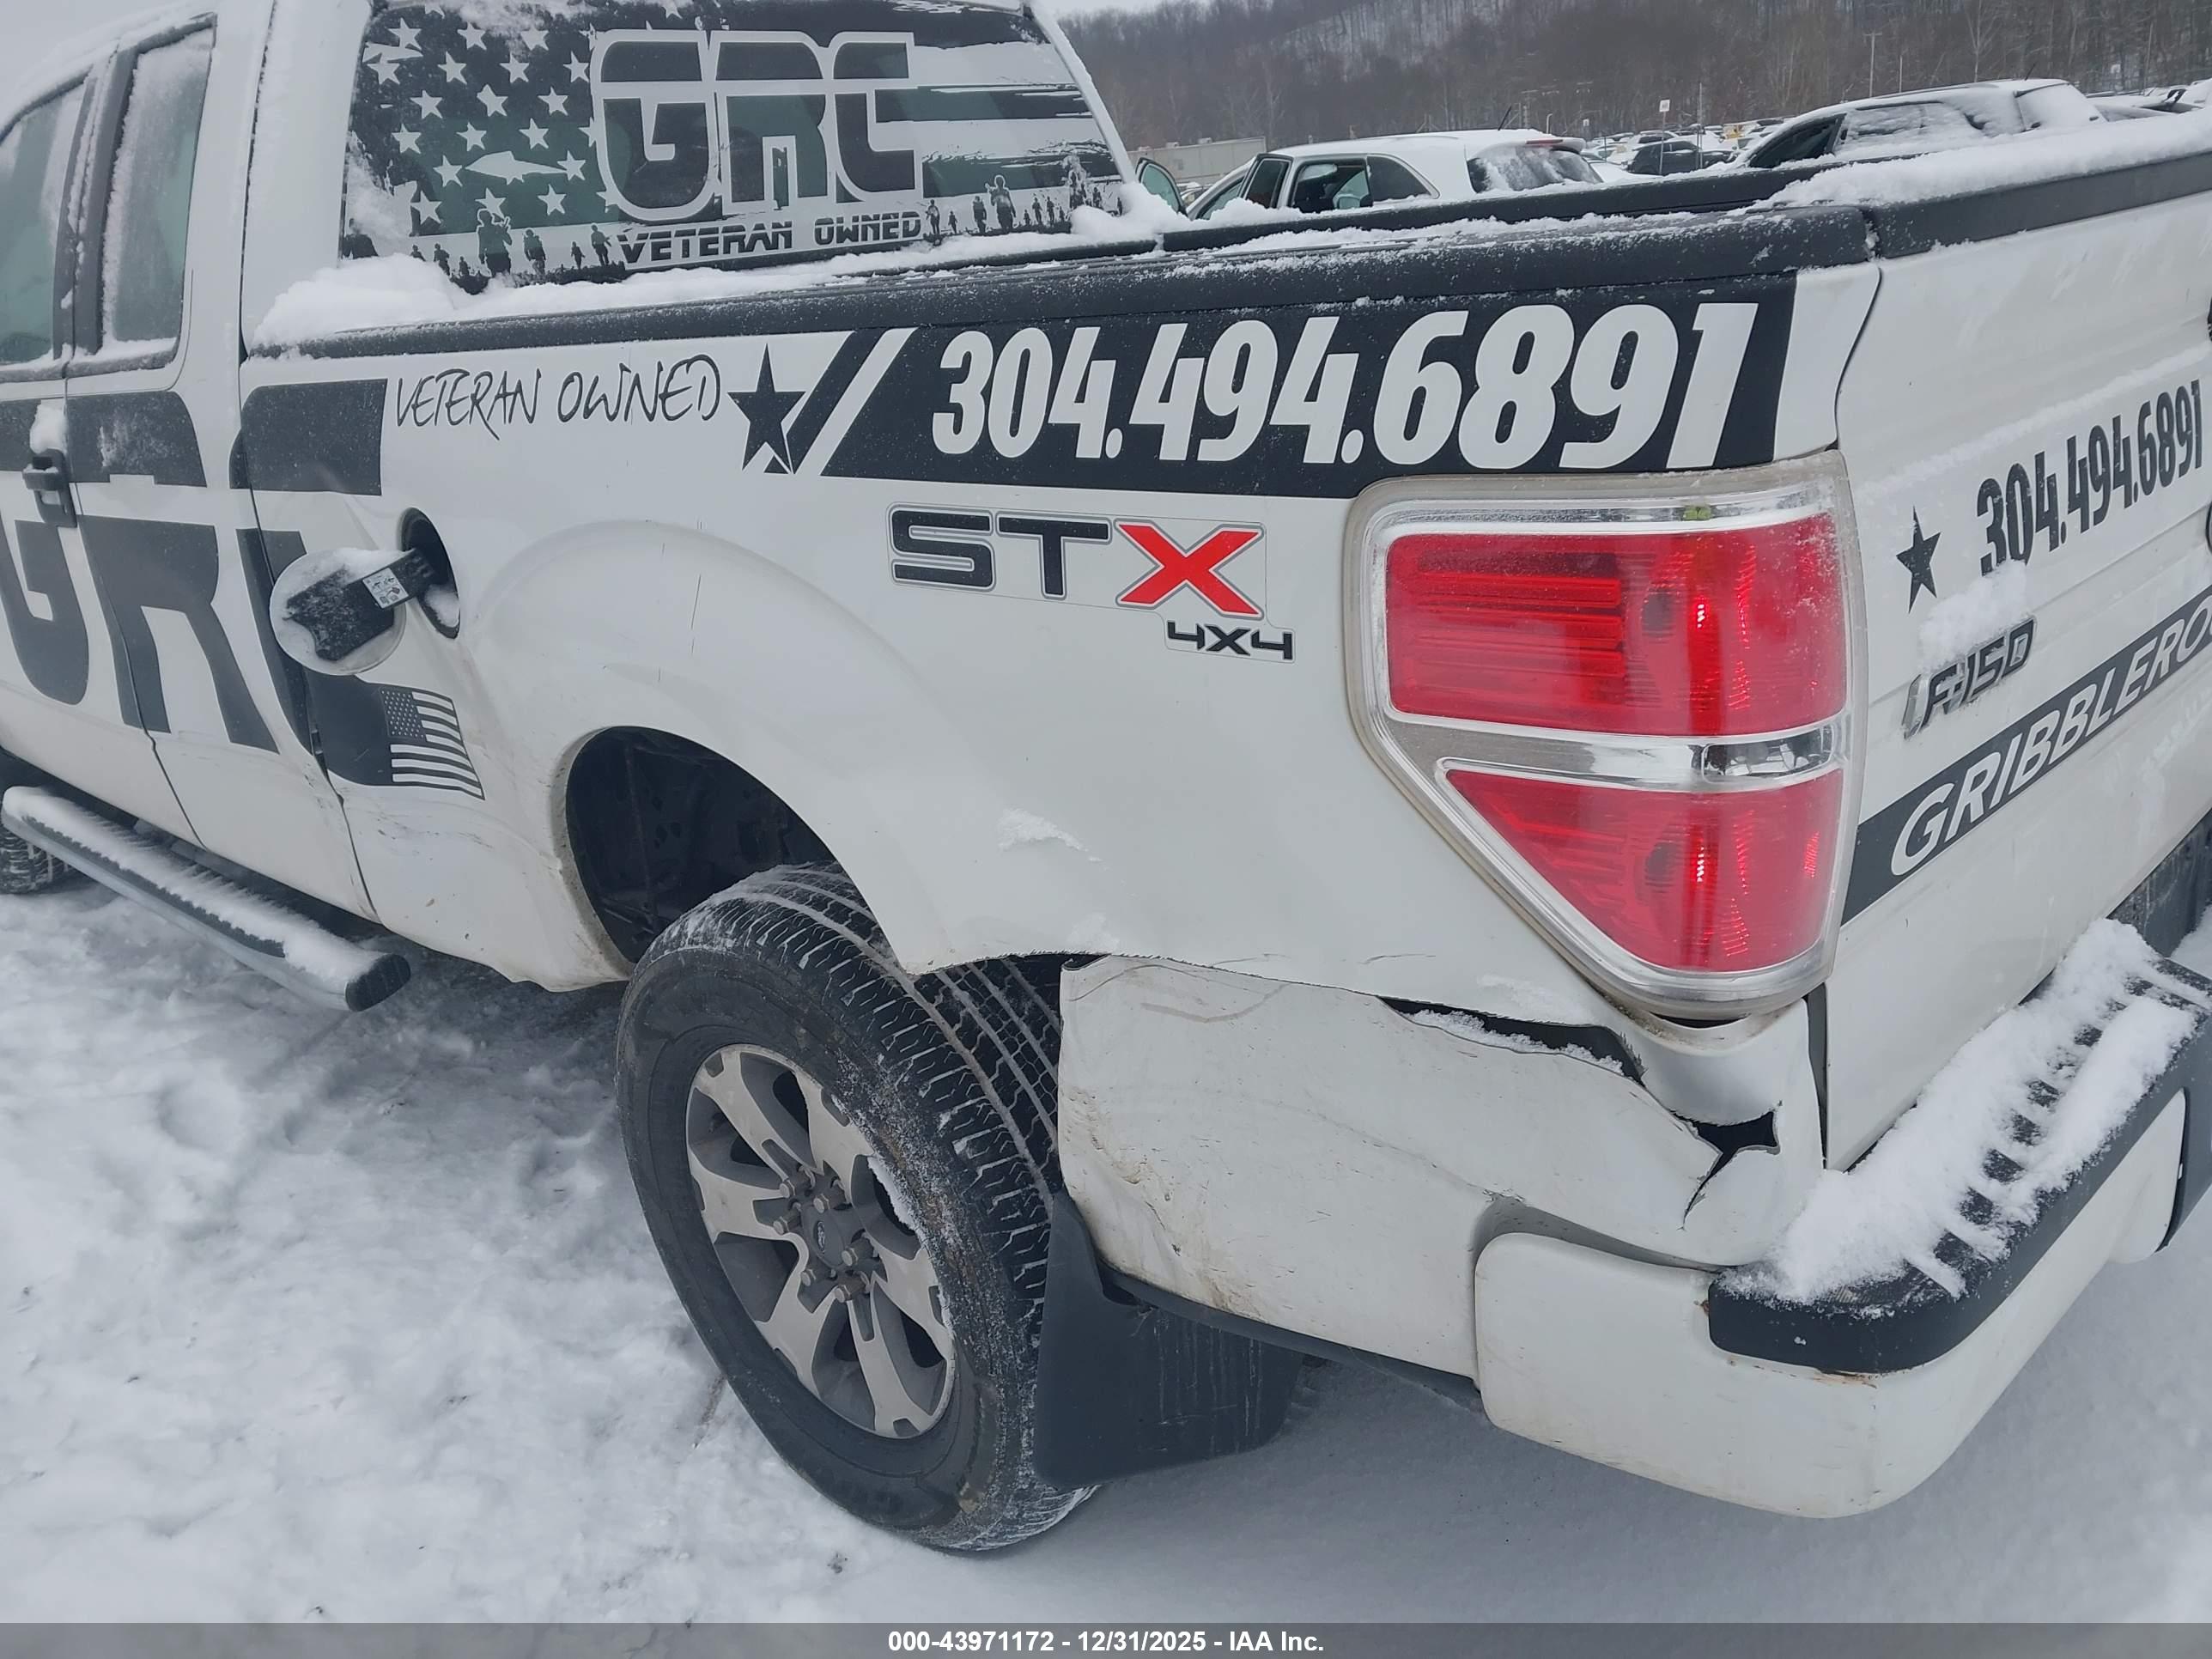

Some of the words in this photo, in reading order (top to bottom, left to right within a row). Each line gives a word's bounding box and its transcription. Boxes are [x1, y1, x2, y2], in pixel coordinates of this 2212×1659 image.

[594, 34, 919, 212] GRC
[617, 220, 792, 265] VETERAN
[813, 211, 921, 245] OWNED
[396, 368, 542, 440] VETERAN
[557, 355, 720, 423] OWNED
[932, 303, 1758, 469] 304.494.6891
[1977, 380, 2203, 576] 304.494.6891
[890, 505, 1264, 619] STX
[1891, 594, 2212, 876] GRIBBLERO
